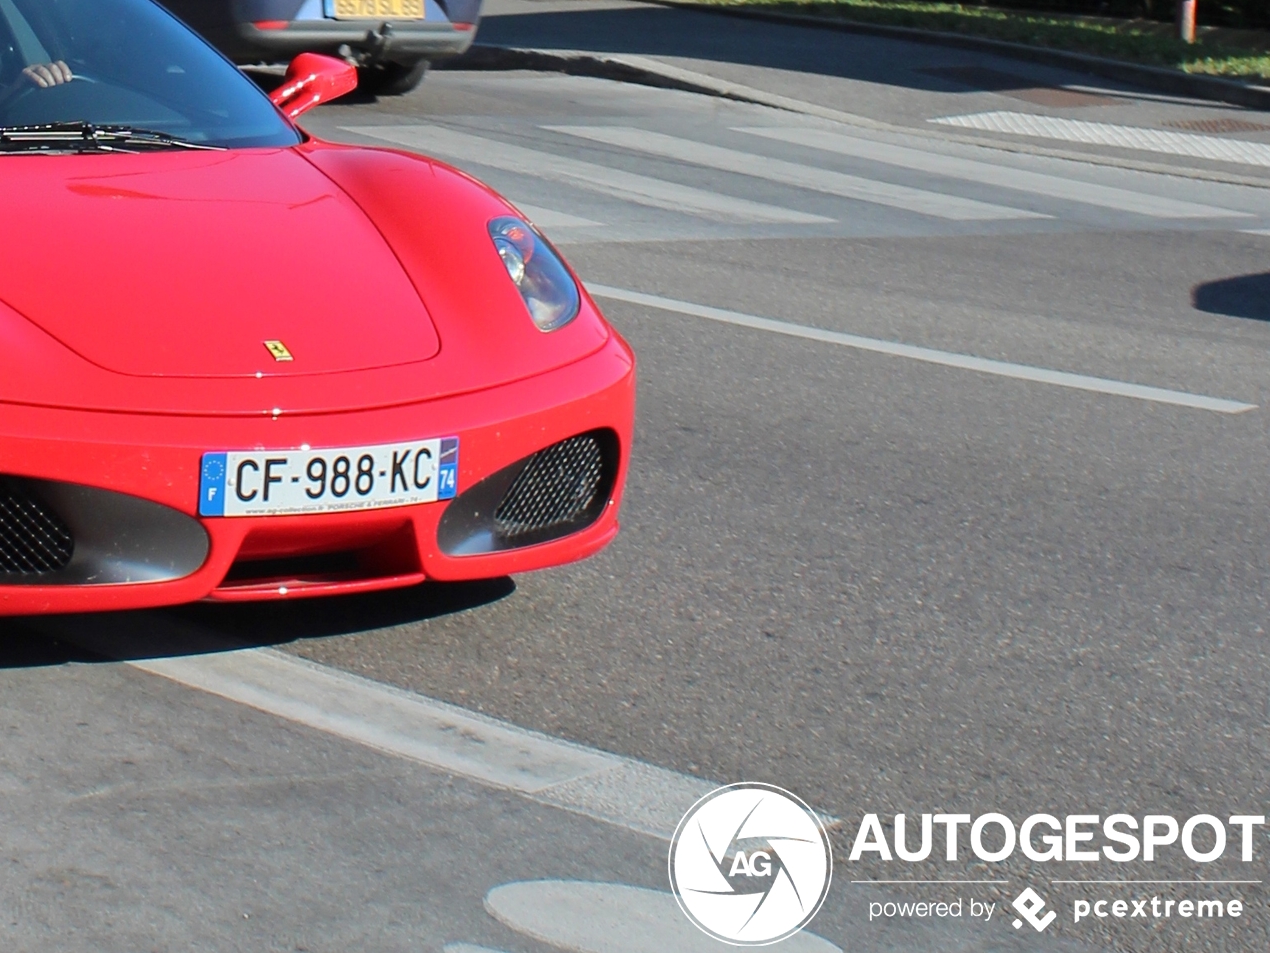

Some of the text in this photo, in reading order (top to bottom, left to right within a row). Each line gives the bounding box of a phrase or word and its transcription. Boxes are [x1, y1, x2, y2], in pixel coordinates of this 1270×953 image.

[235, 447, 432, 502] CF-988-KC
[440, 469, 455, 489] 74
[208, 487, 218, 501] F
